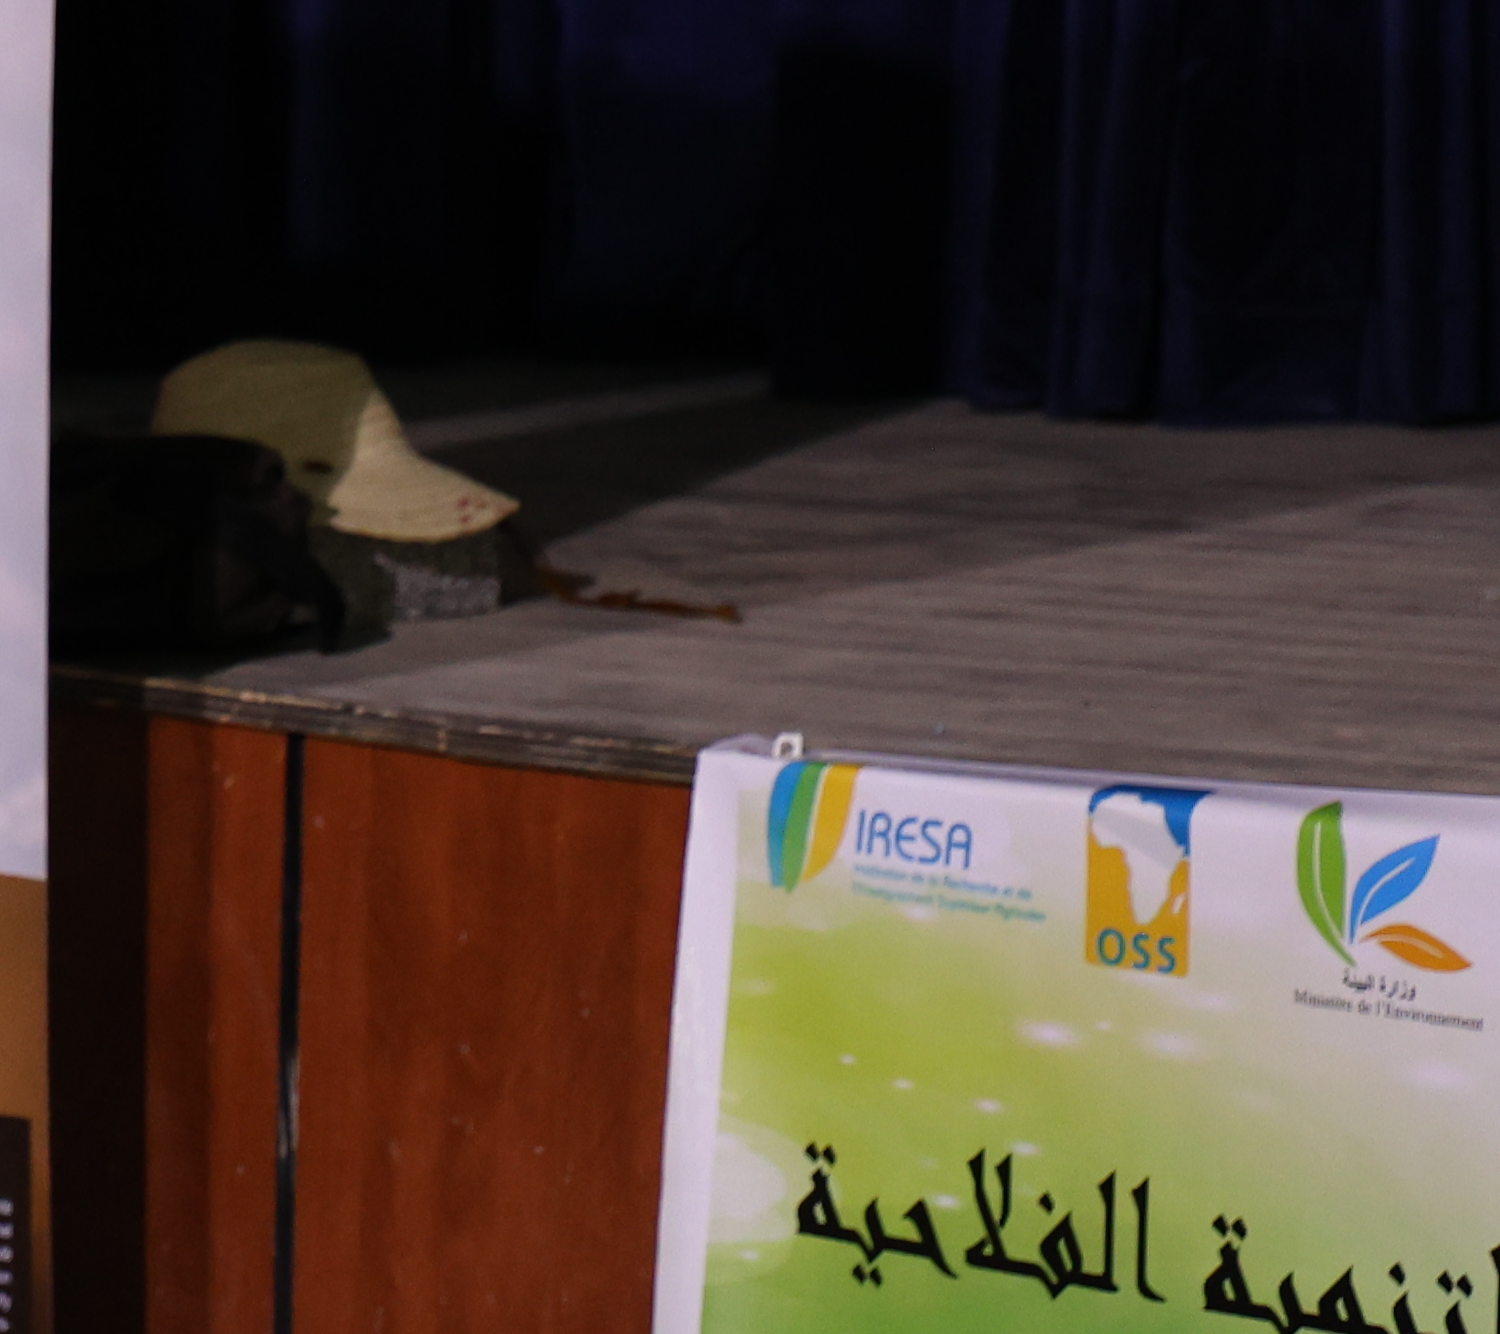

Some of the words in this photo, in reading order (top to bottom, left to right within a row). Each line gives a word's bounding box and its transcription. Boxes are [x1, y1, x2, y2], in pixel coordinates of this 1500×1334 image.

[854, 808, 975, 871] IRESA
[1097, 927, 1178, 975] OSS
[795, 1141, 1167, 1304] الفلاحية
